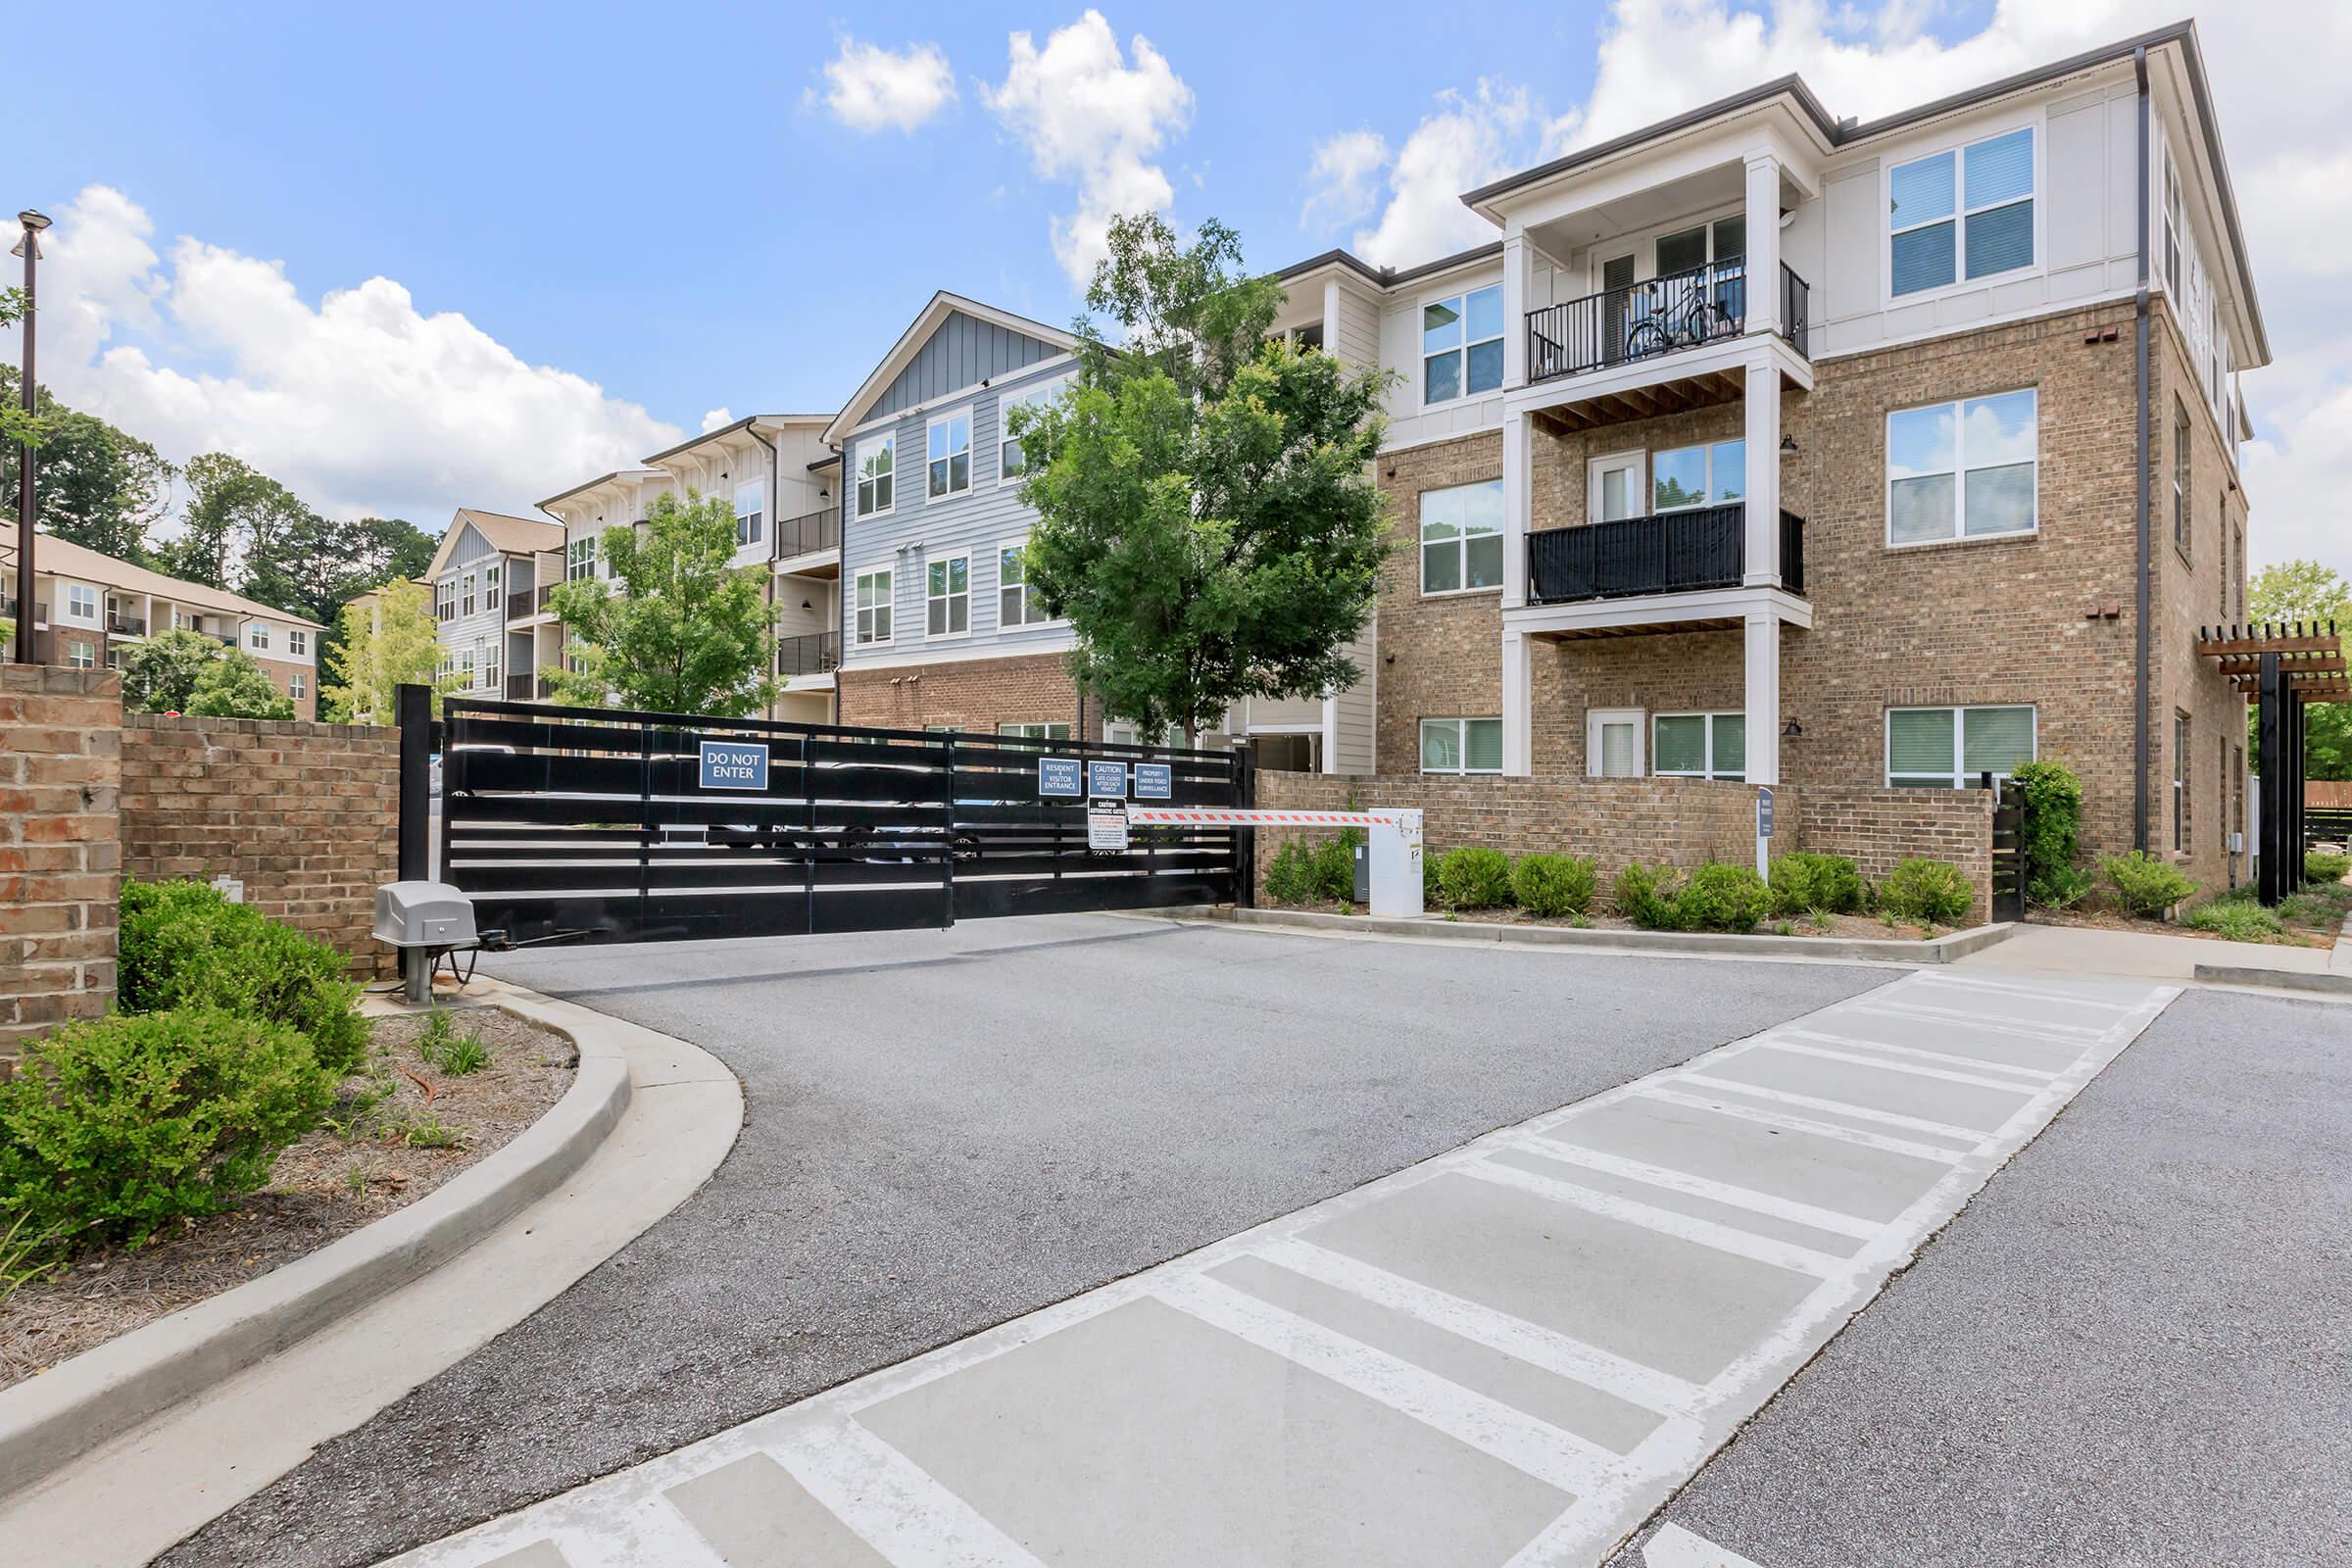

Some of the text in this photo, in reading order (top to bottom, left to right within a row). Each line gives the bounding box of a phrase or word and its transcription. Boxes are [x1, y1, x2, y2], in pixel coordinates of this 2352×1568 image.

[708, 753, 760, 766] DO NOT
[713, 766, 754, 779] ENTER
[1094, 764, 1121, 773] CAUTION
